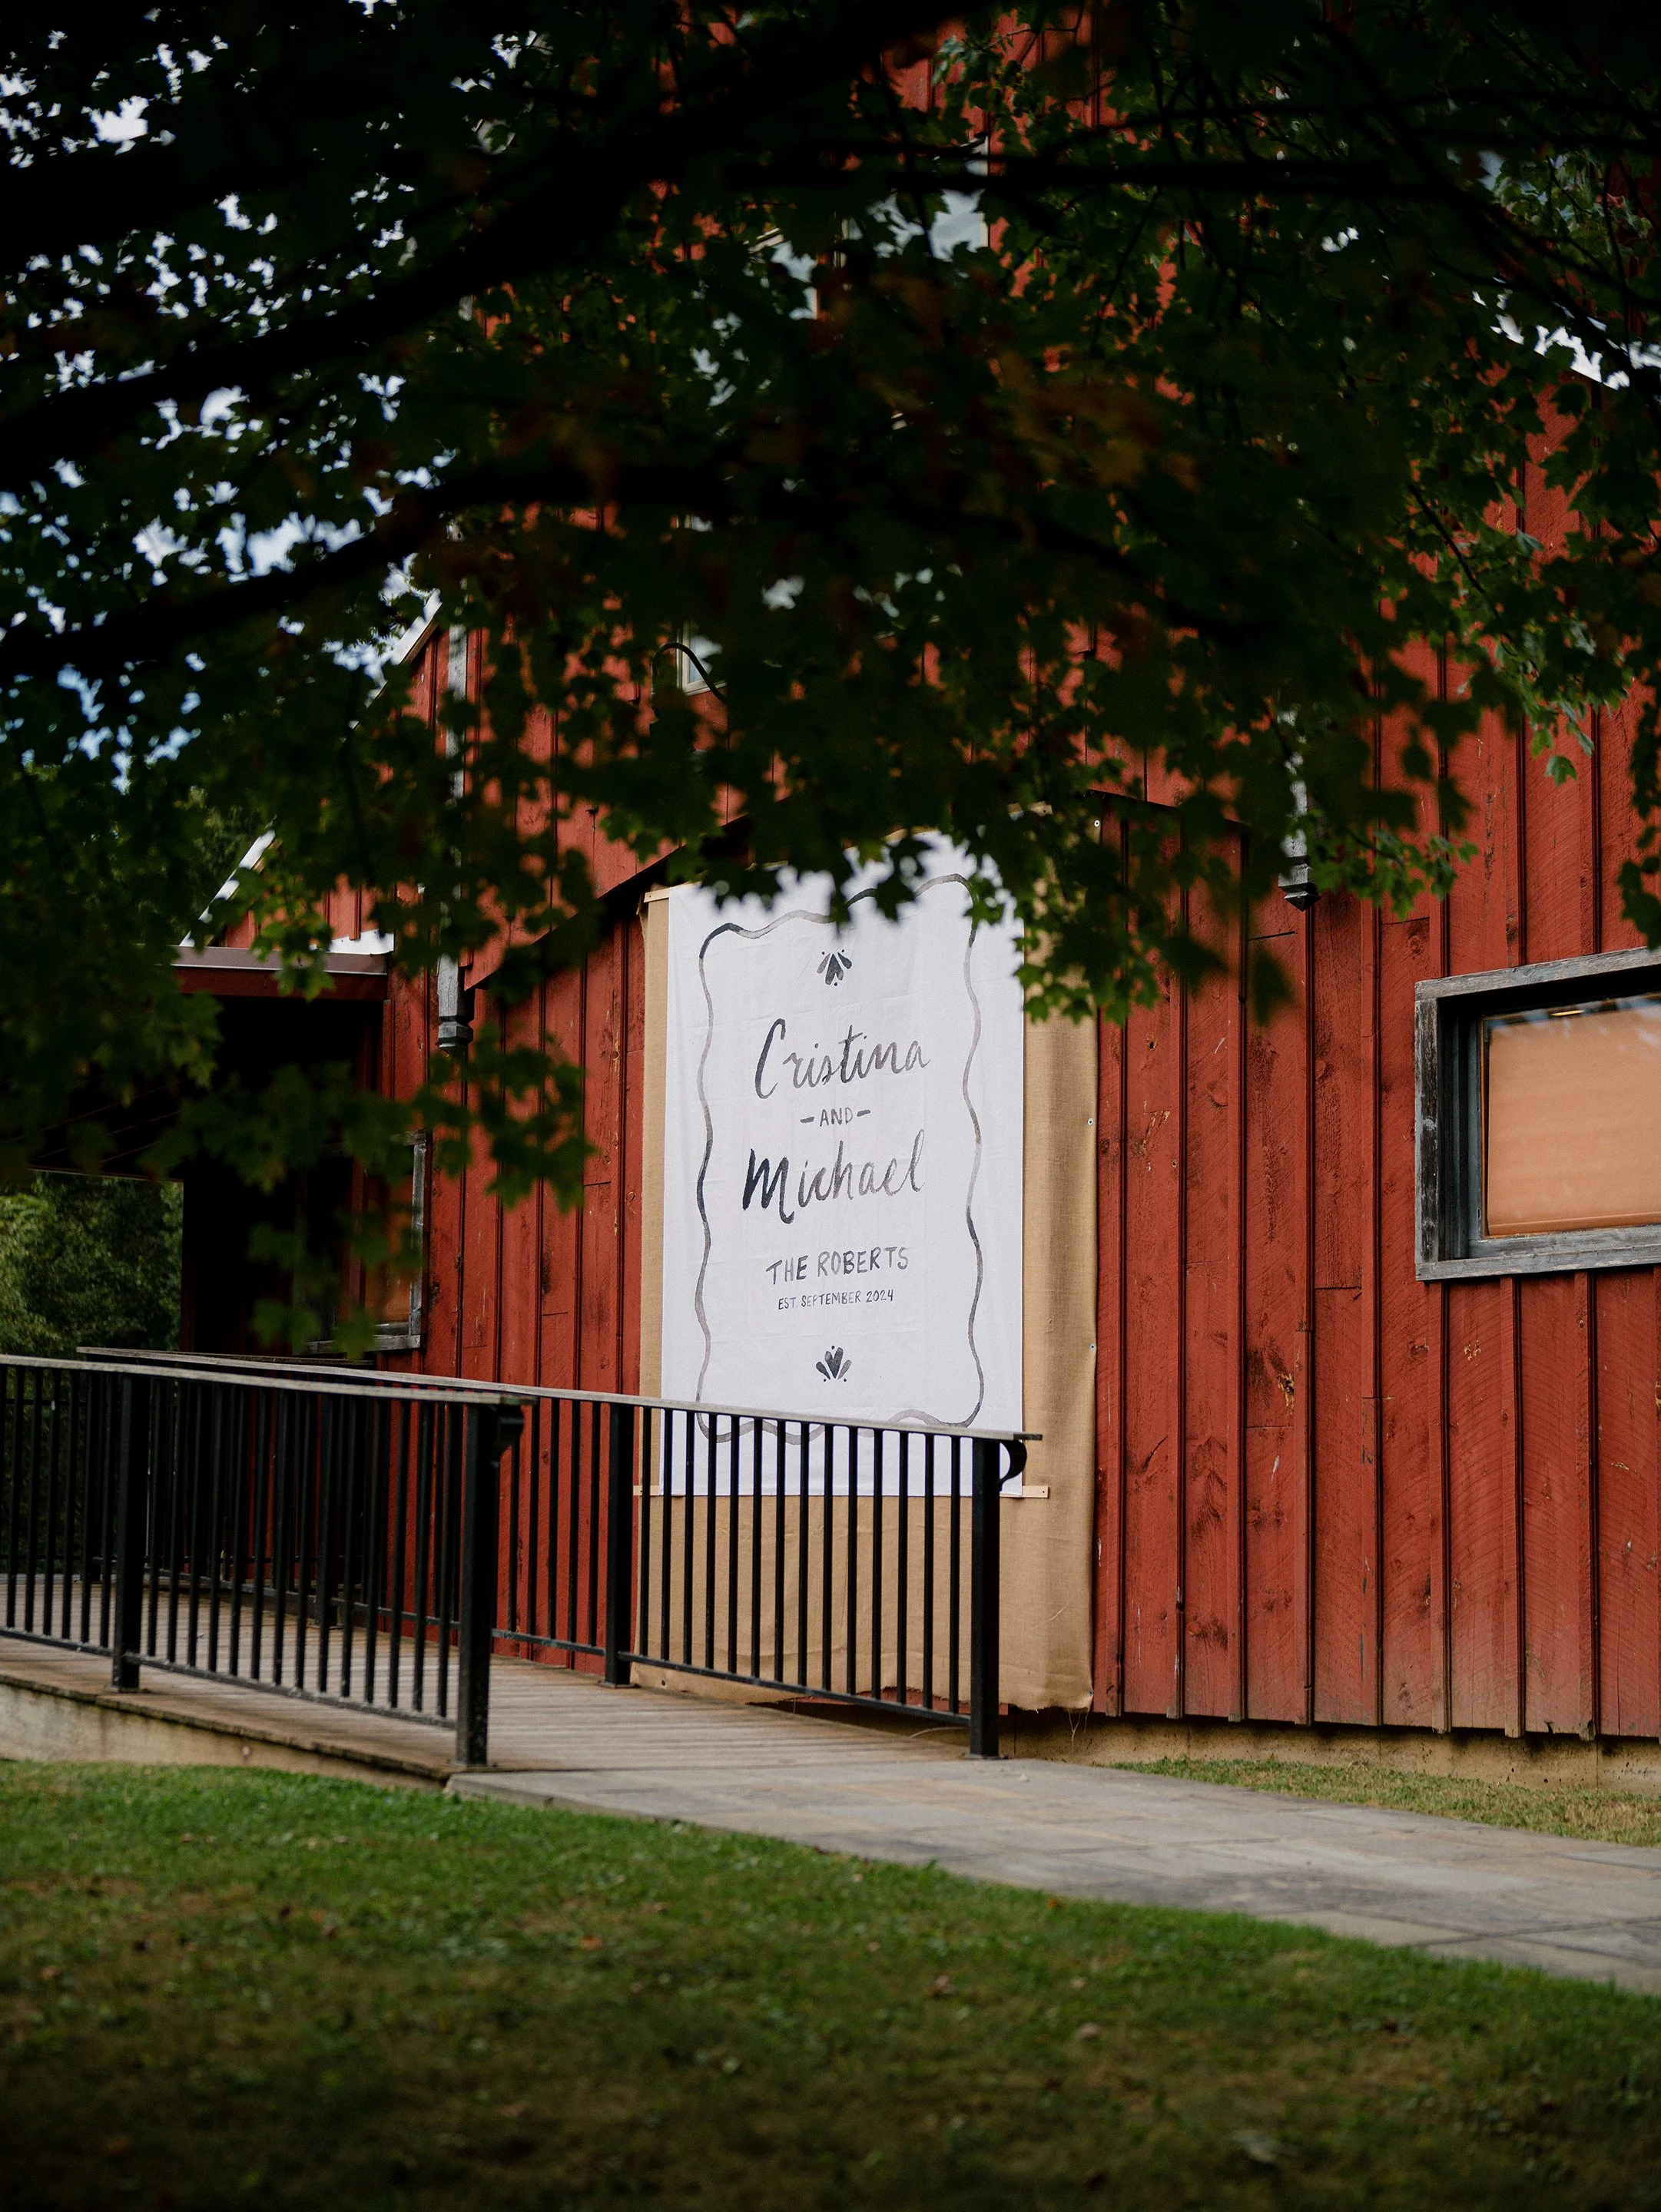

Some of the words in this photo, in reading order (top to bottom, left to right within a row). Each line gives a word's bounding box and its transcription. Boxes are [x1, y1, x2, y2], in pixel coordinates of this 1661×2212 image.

[754, 1018, 931, 1099] Cristina
[742, 1128, 925, 1224] Michael
[765, 1254, 809, 1285] THE
[817, 1246, 910, 1277] ROBERTS
[777, 1297, 798, 1310] EST.
[801, 1290, 861, 1307] SEPTEMBER
[865, 1289, 894, 1303] 2024
